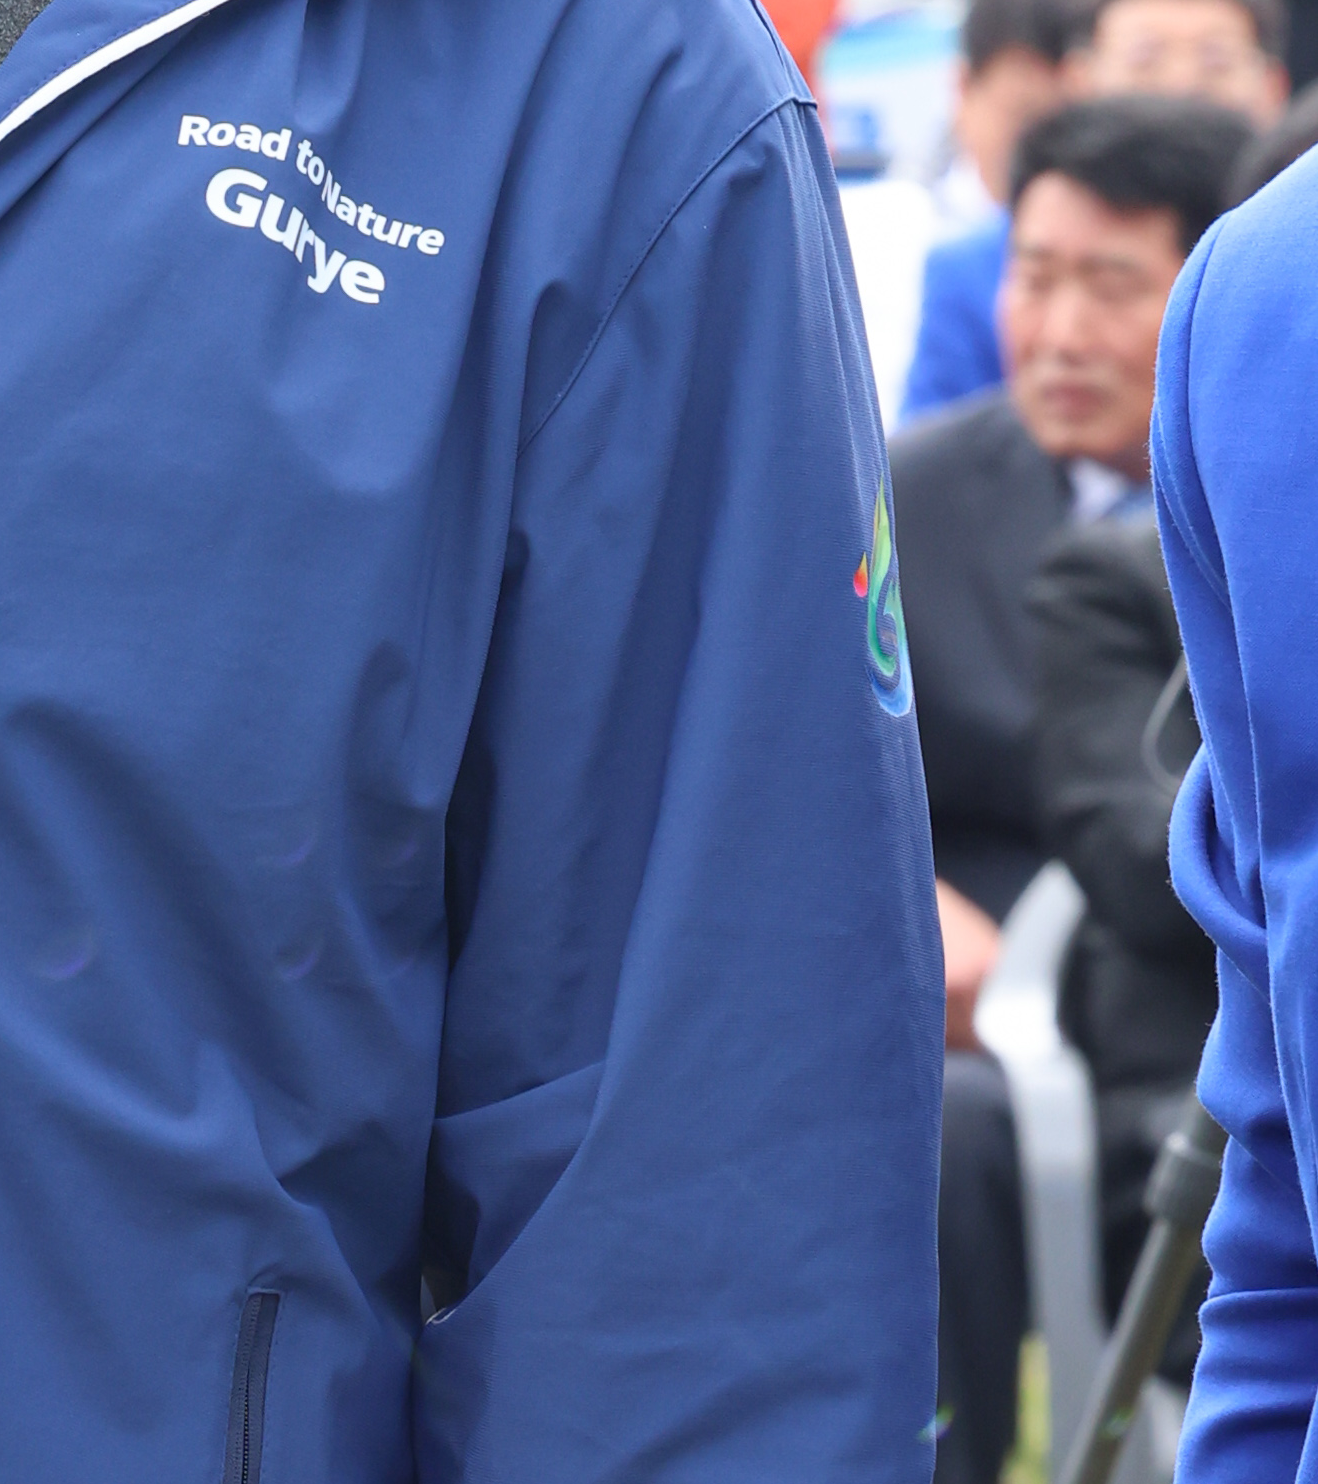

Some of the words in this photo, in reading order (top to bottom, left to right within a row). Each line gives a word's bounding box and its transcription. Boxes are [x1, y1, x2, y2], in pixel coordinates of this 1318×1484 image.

[176, 113, 293, 162] Road
[295, 138, 325, 186] to
[320, 169, 446, 256] Nature
[204, 166, 386, 305] Gurye
